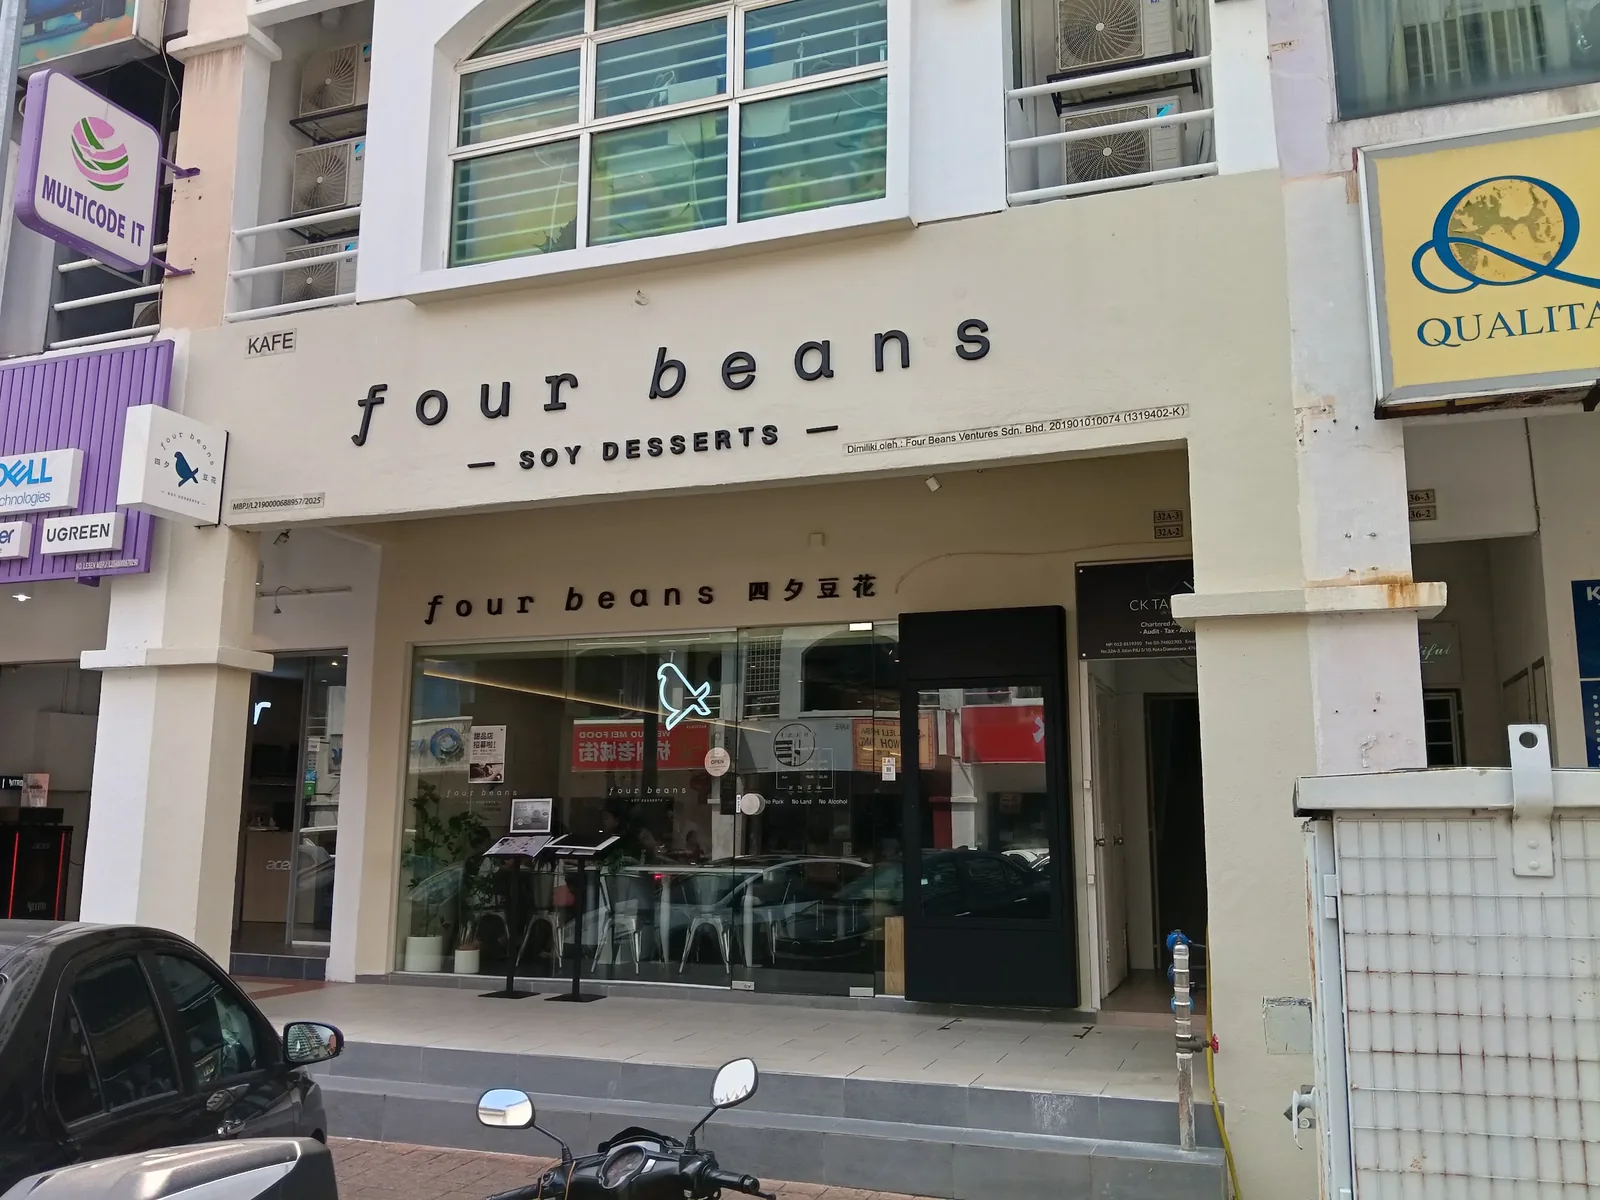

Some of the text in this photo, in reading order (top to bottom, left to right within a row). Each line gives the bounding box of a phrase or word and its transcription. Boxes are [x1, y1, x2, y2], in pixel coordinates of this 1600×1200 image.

[42, 174, 145, 247] MULTICODE IT
[248, 332, 293, 354] KAFE
[351, 318, 990, 446] four beans
[847, 443, 877, 454] Dimiliki
[879, 440, 898, 450] oleh
[905, 437, 926, 447] Four
[928, 434, 956, 444] Beans
[958, 428, 999, 441] Ventures
[1001, 426, 1022, 436] Sdn.
[1025, 423, 1046, 433] Bhd.
[1049, 414, 1120, 431] 201901010074
[1123, 406, 1185, 423] (1319402-K)
[519, 424, 778, 469] SOY DESSERTS
[0, 492, 51, 507] chnologies
[1156, 511, 1180, 521] 32A-3
[0, 528, 15, 544] er
[46, 523, 110, 542] UGREEN
[1157, 527, 1180, 537] 32A-2
[748, 574, 876, 602] 四夕豆花
[424, 584, 714, 625] four beans
[1129, 598, 1171, 611] CK TA
[608, 786, 686, 796] four beans
